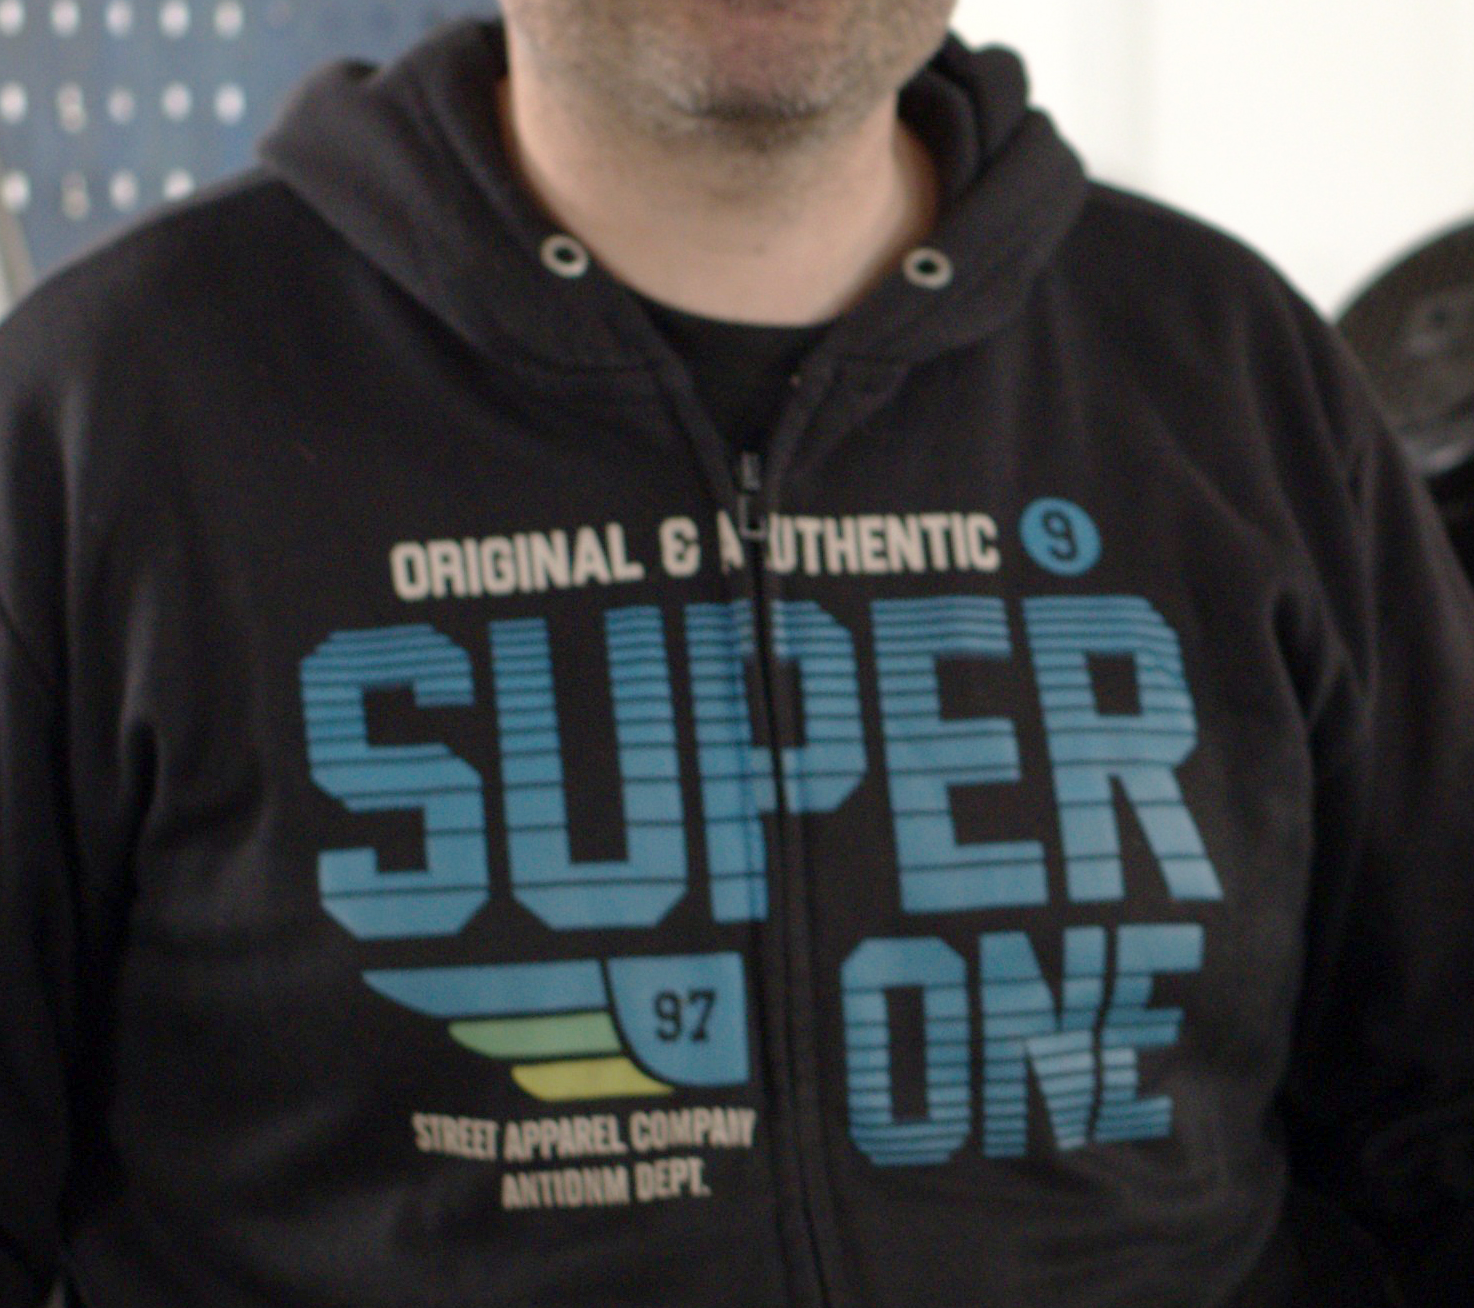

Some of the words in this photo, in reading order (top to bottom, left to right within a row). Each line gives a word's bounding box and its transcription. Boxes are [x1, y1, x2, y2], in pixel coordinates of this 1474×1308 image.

[390, 523, 645, 601] ORIGINAL
[658, 514, 702, 579] &
[1040, 509, 1080, 563] 9
[299, 595, 1224, 940] SUPER
[653, 988, 717, 1043] 97
[840, 923, 1204, 1166] ONE
[412, 1111, 499, 1160] STREET
[502, 1114, 628, 1163] APPAREL
